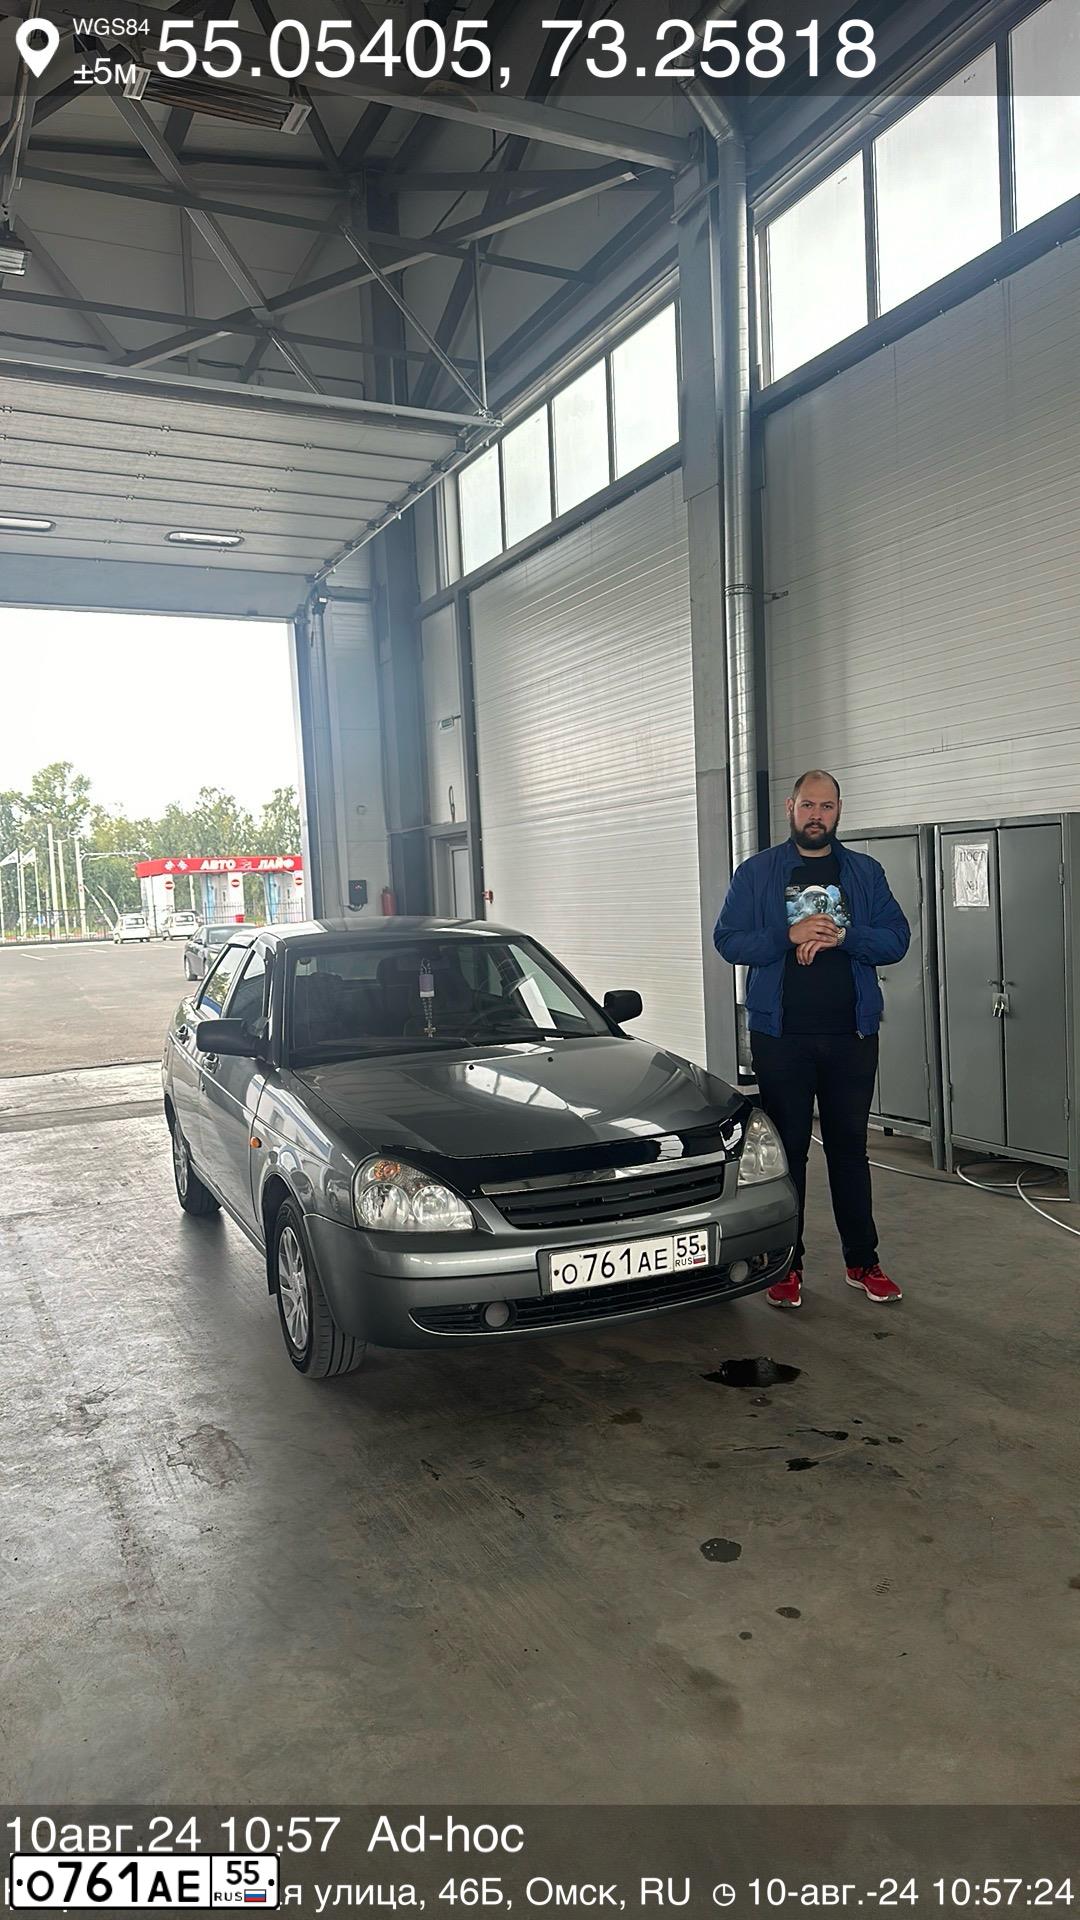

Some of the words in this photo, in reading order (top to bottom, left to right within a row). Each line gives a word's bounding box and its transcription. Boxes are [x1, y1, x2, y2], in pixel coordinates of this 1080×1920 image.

[200, 859, 237, 870] АВТО
[258, 857, 295, 870] ЛАЙФ
[561, 1247, 668, 1285] О761АЕ
[676, 1234, 700, 1258] 55
[674, 1257, 693, 1268] RUS
